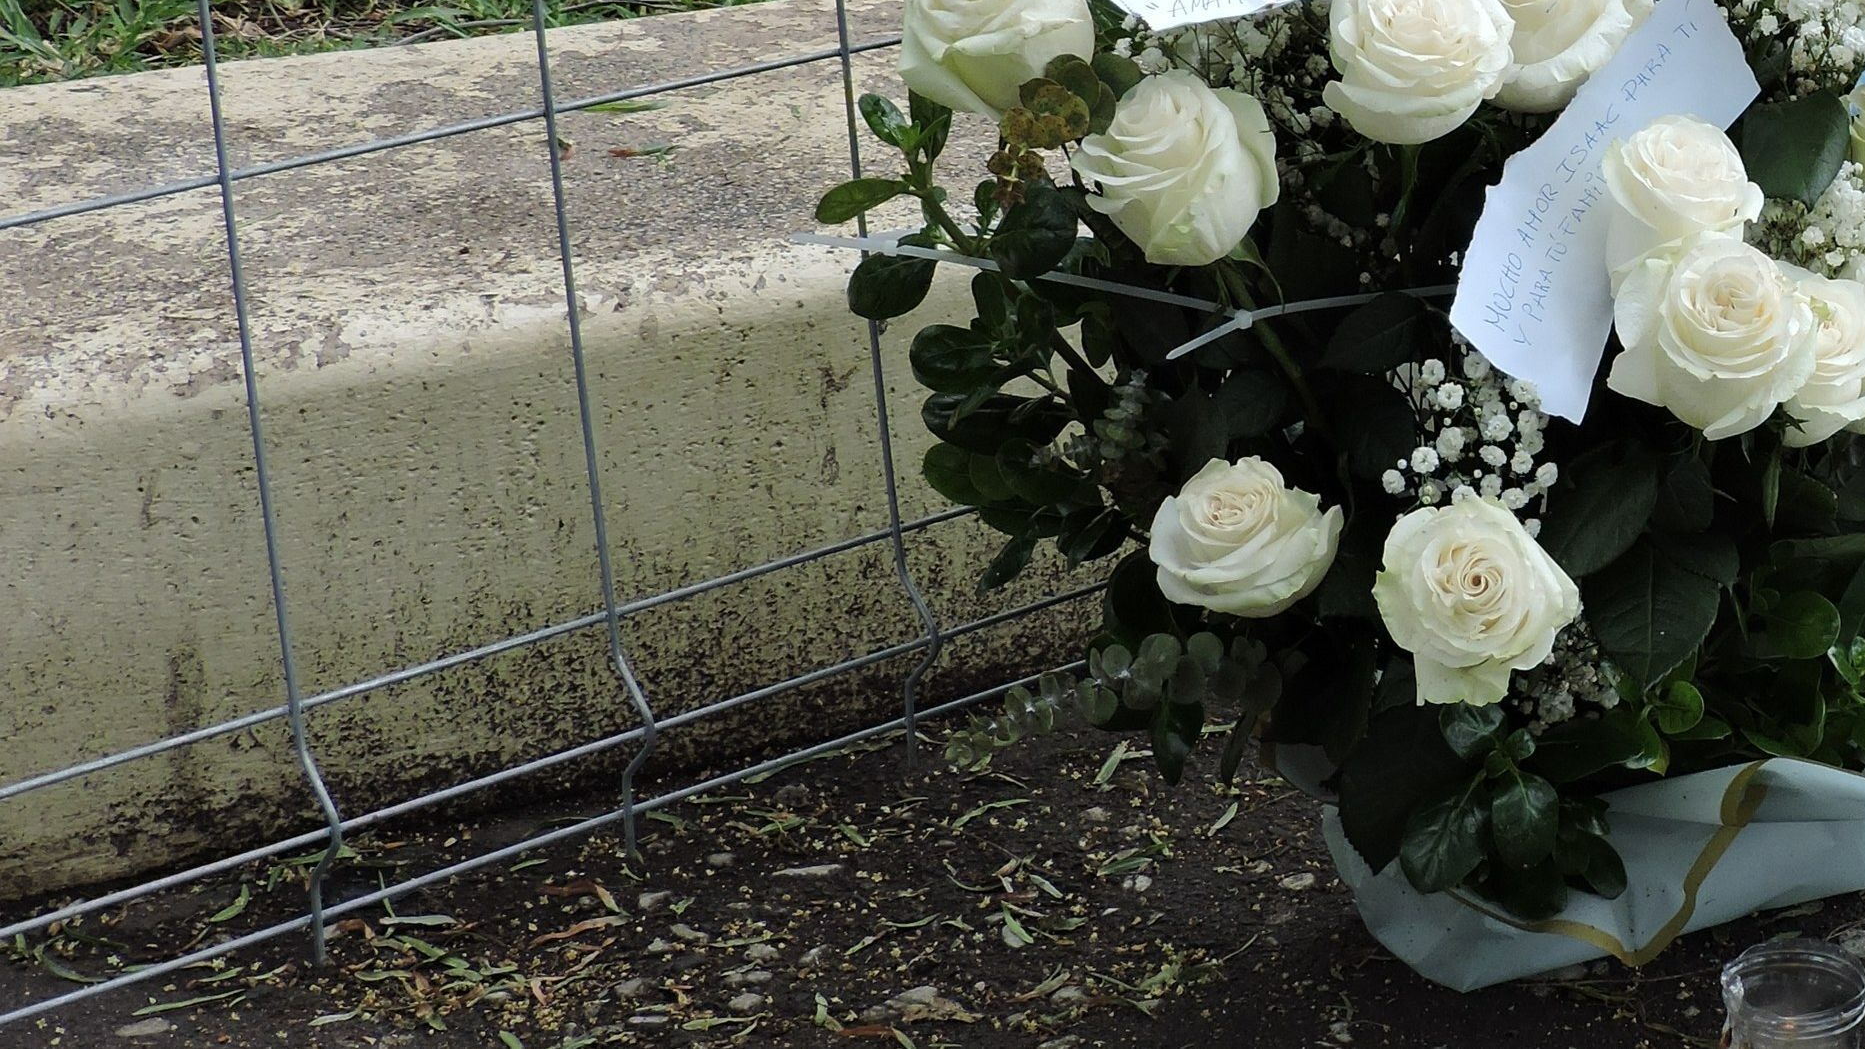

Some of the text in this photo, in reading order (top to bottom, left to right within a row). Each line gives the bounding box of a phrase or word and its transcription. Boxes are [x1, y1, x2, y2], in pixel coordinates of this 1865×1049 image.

[1482, 252, 1523, 333] MUCHO
[1516, 183, 1559, 248] AMOR
[1555, 104, 1620, 184] ISAAC
[1521, 268, 1553, 323] PARA
